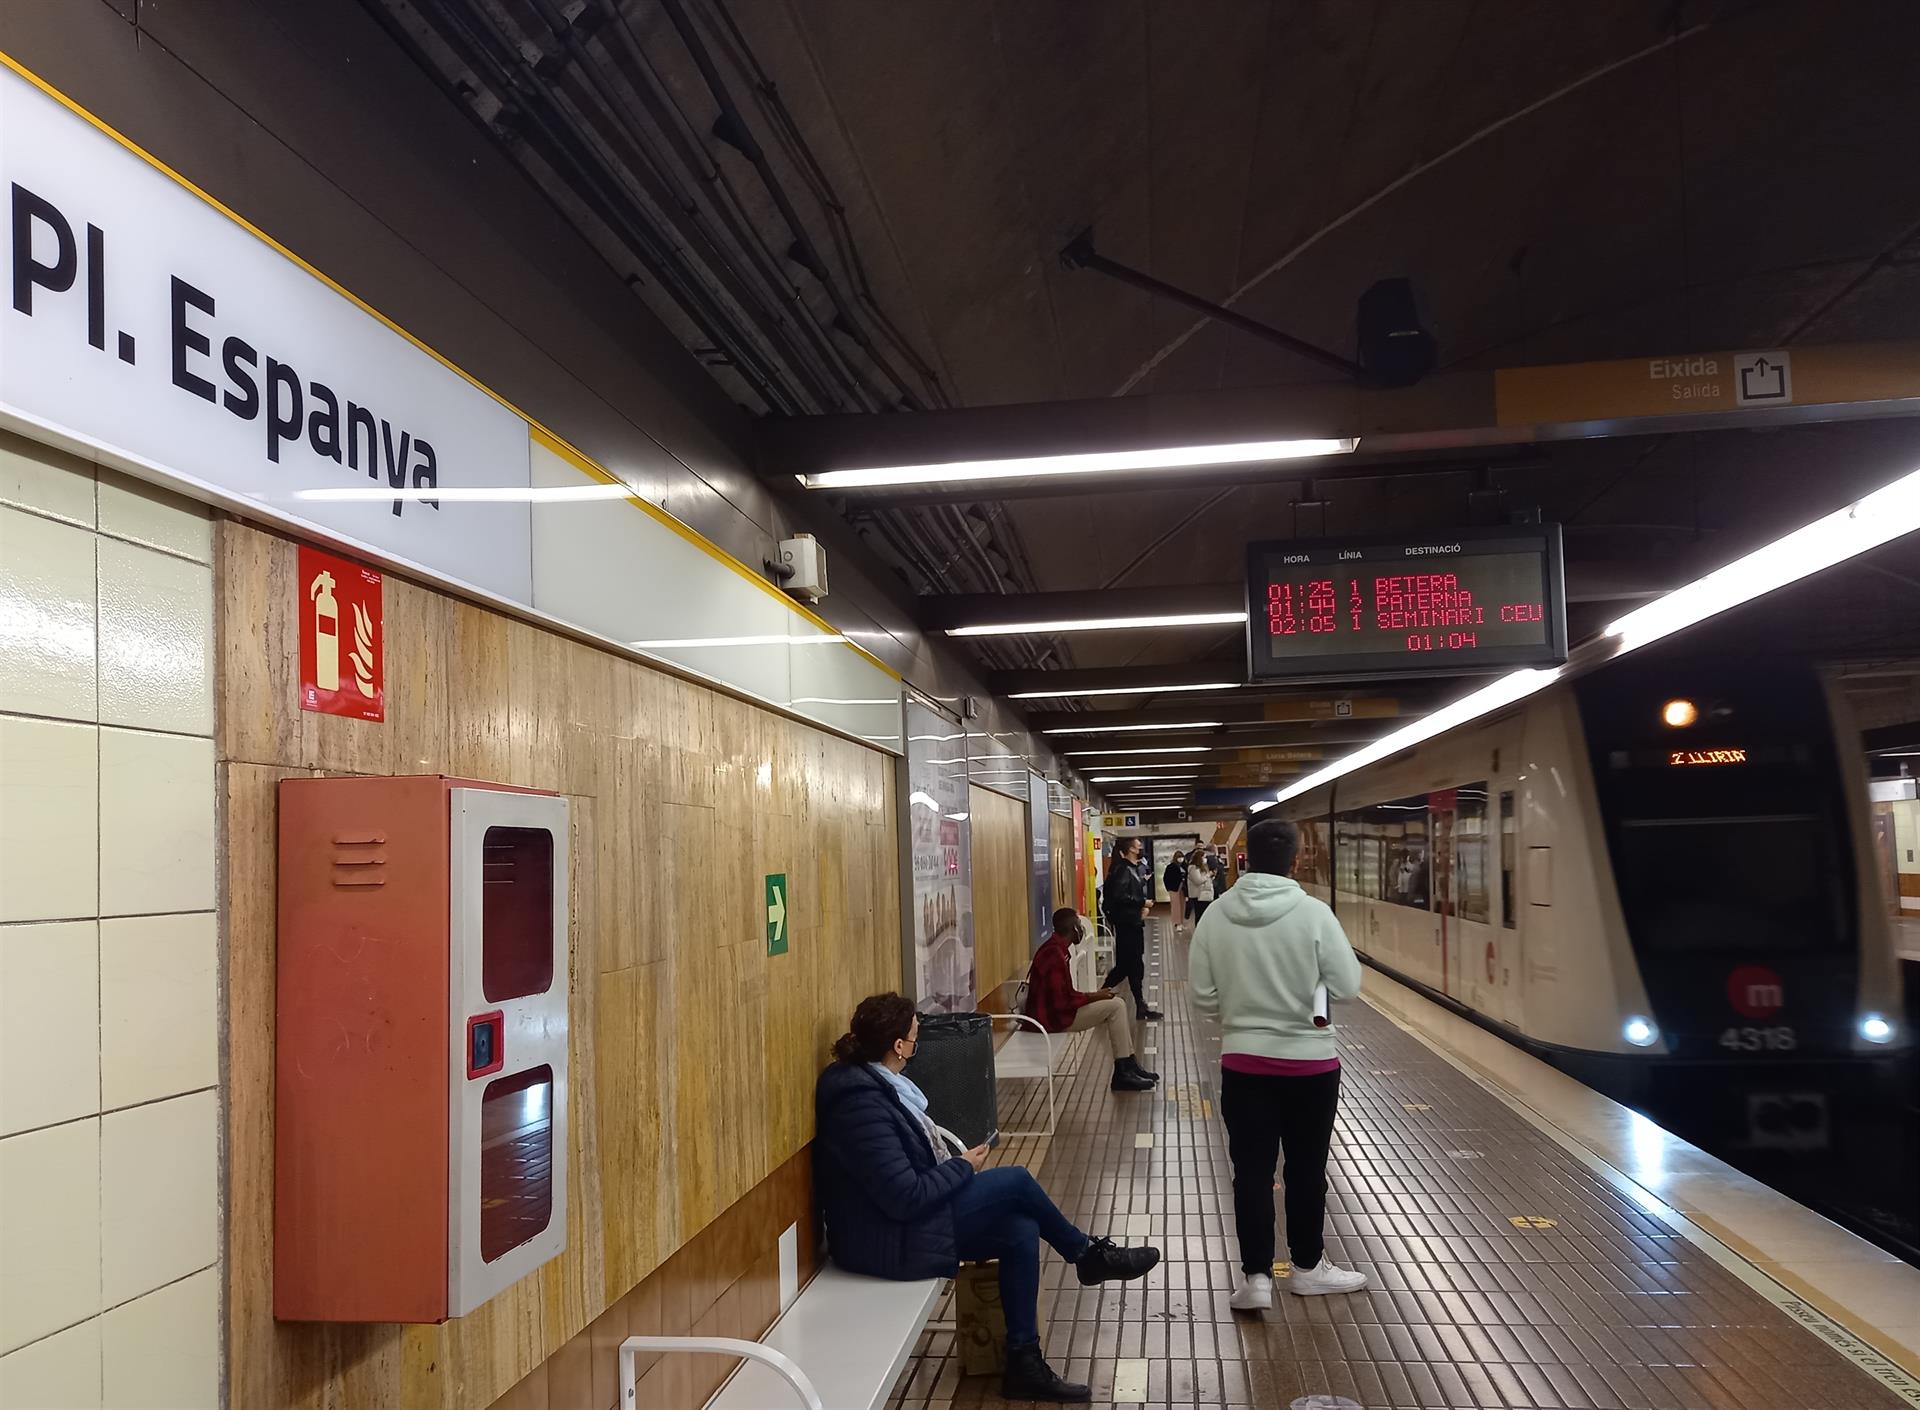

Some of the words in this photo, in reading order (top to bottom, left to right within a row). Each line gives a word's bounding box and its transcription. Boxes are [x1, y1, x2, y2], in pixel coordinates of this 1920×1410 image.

[11, 181, 136, 366] Pl.
[170, 273, 441, 517] Espanya
[1649, 358, 1719, 379] Eixida
[1672, 383, 1720, 399] Salida
[1283, 555, 1310, 564] HORA
[1338, 550, 1362, 560] LÍNIA
[1405, 543, 1461, 555] DESTINACIÓ
[1268, 580, 1335, 600] 01:25
[1351, 579, 1360, 596] 1
[1375, 574, 1457, 594] BETERA
[1269, 598, 1335, 617] 01:44
[1350, 596, 1362, 613] 2
[1376, 591, 1472, 611] PATERNA
[1270, 615, 1336, 635] 02:05
[1352, 614, 1361, 630] 1
[1377, 607, 1484, 629] SEMINARI
[1501, 604, 1543, 622] CEU
[1408, 632, 1476, 651] 01:04
[1719, 1026, 1797, 1050] 4318
[1873, 1368, 1910, 1386] tren
